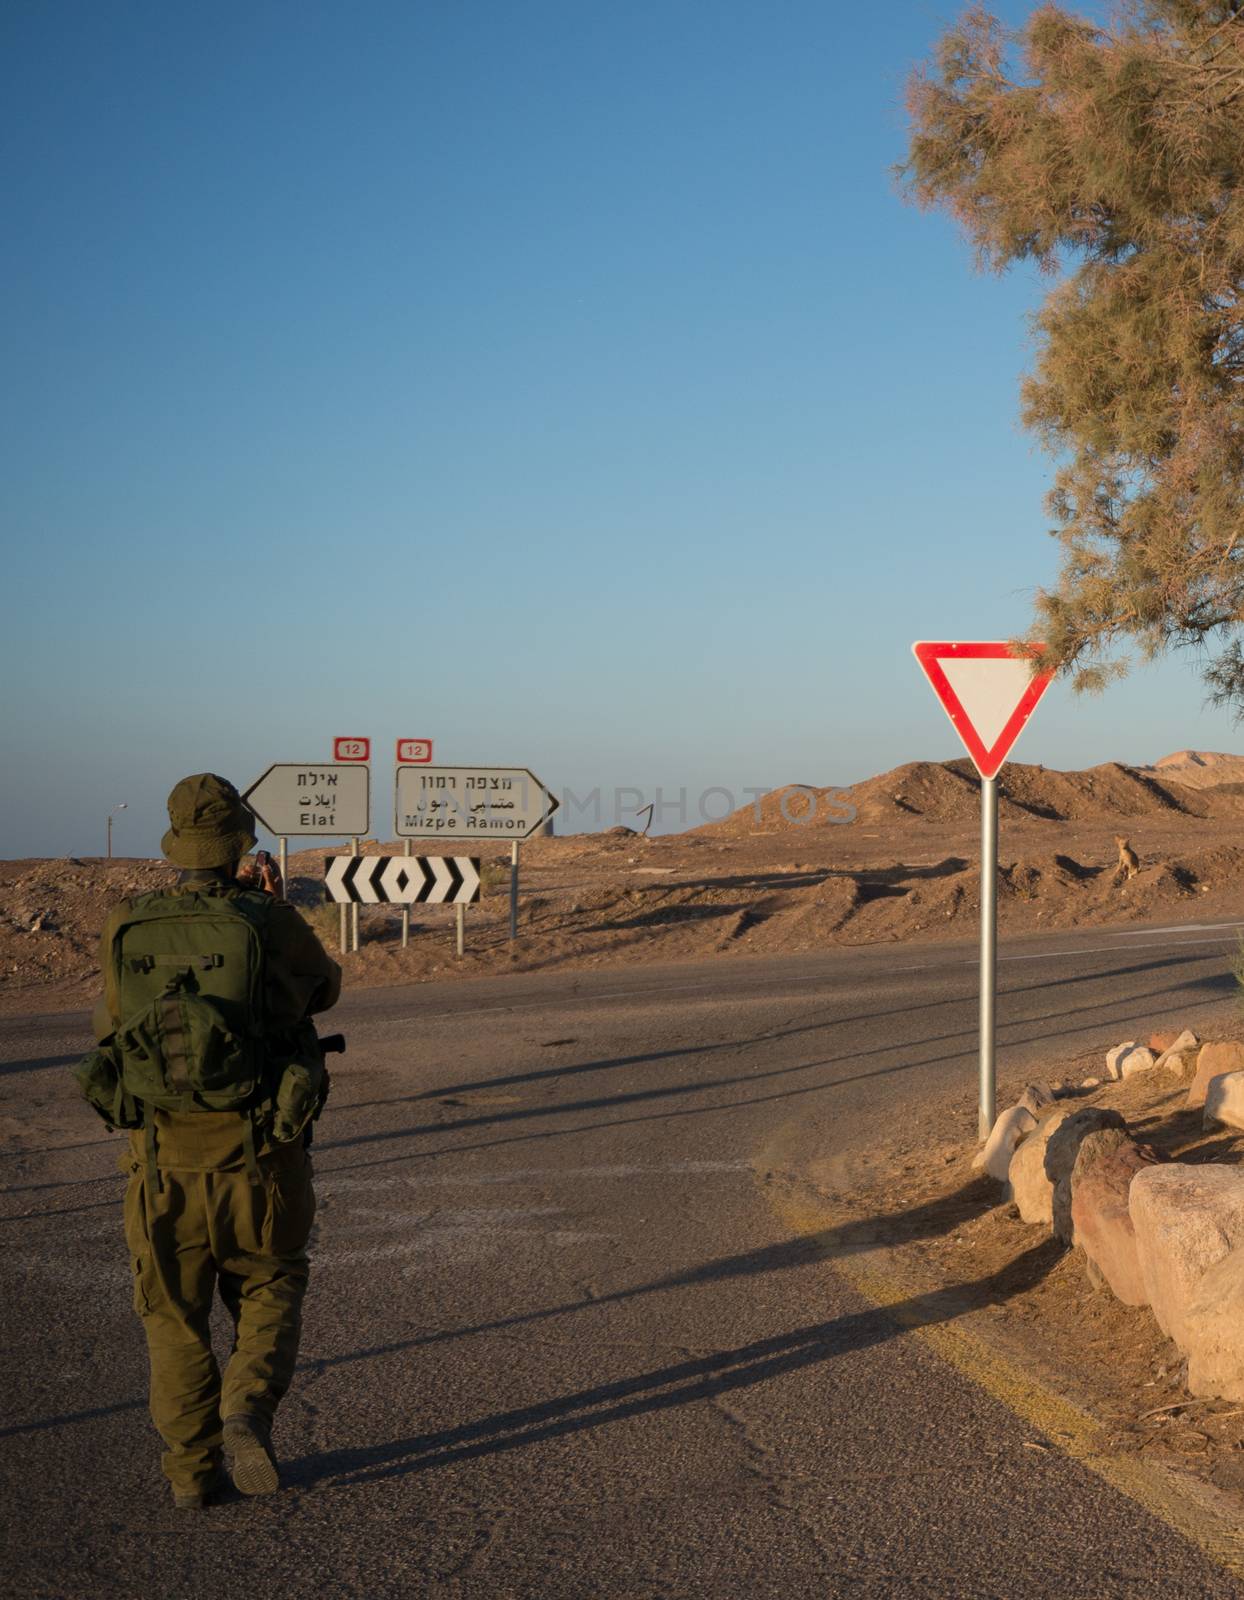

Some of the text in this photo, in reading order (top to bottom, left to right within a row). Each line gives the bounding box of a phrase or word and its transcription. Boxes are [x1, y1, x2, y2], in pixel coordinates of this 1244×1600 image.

[344, 744, 360, 755] 12
[407, 746, 422, 756] 12
[297, 772, 338, 786] אילת
[420, 776, 512, 790] מצפה רמון
[299, 794, 336, 812] إيلات
[300, 813, 335, 826] Elat
[405, 815, 526, 831] Mizpe Ramon
